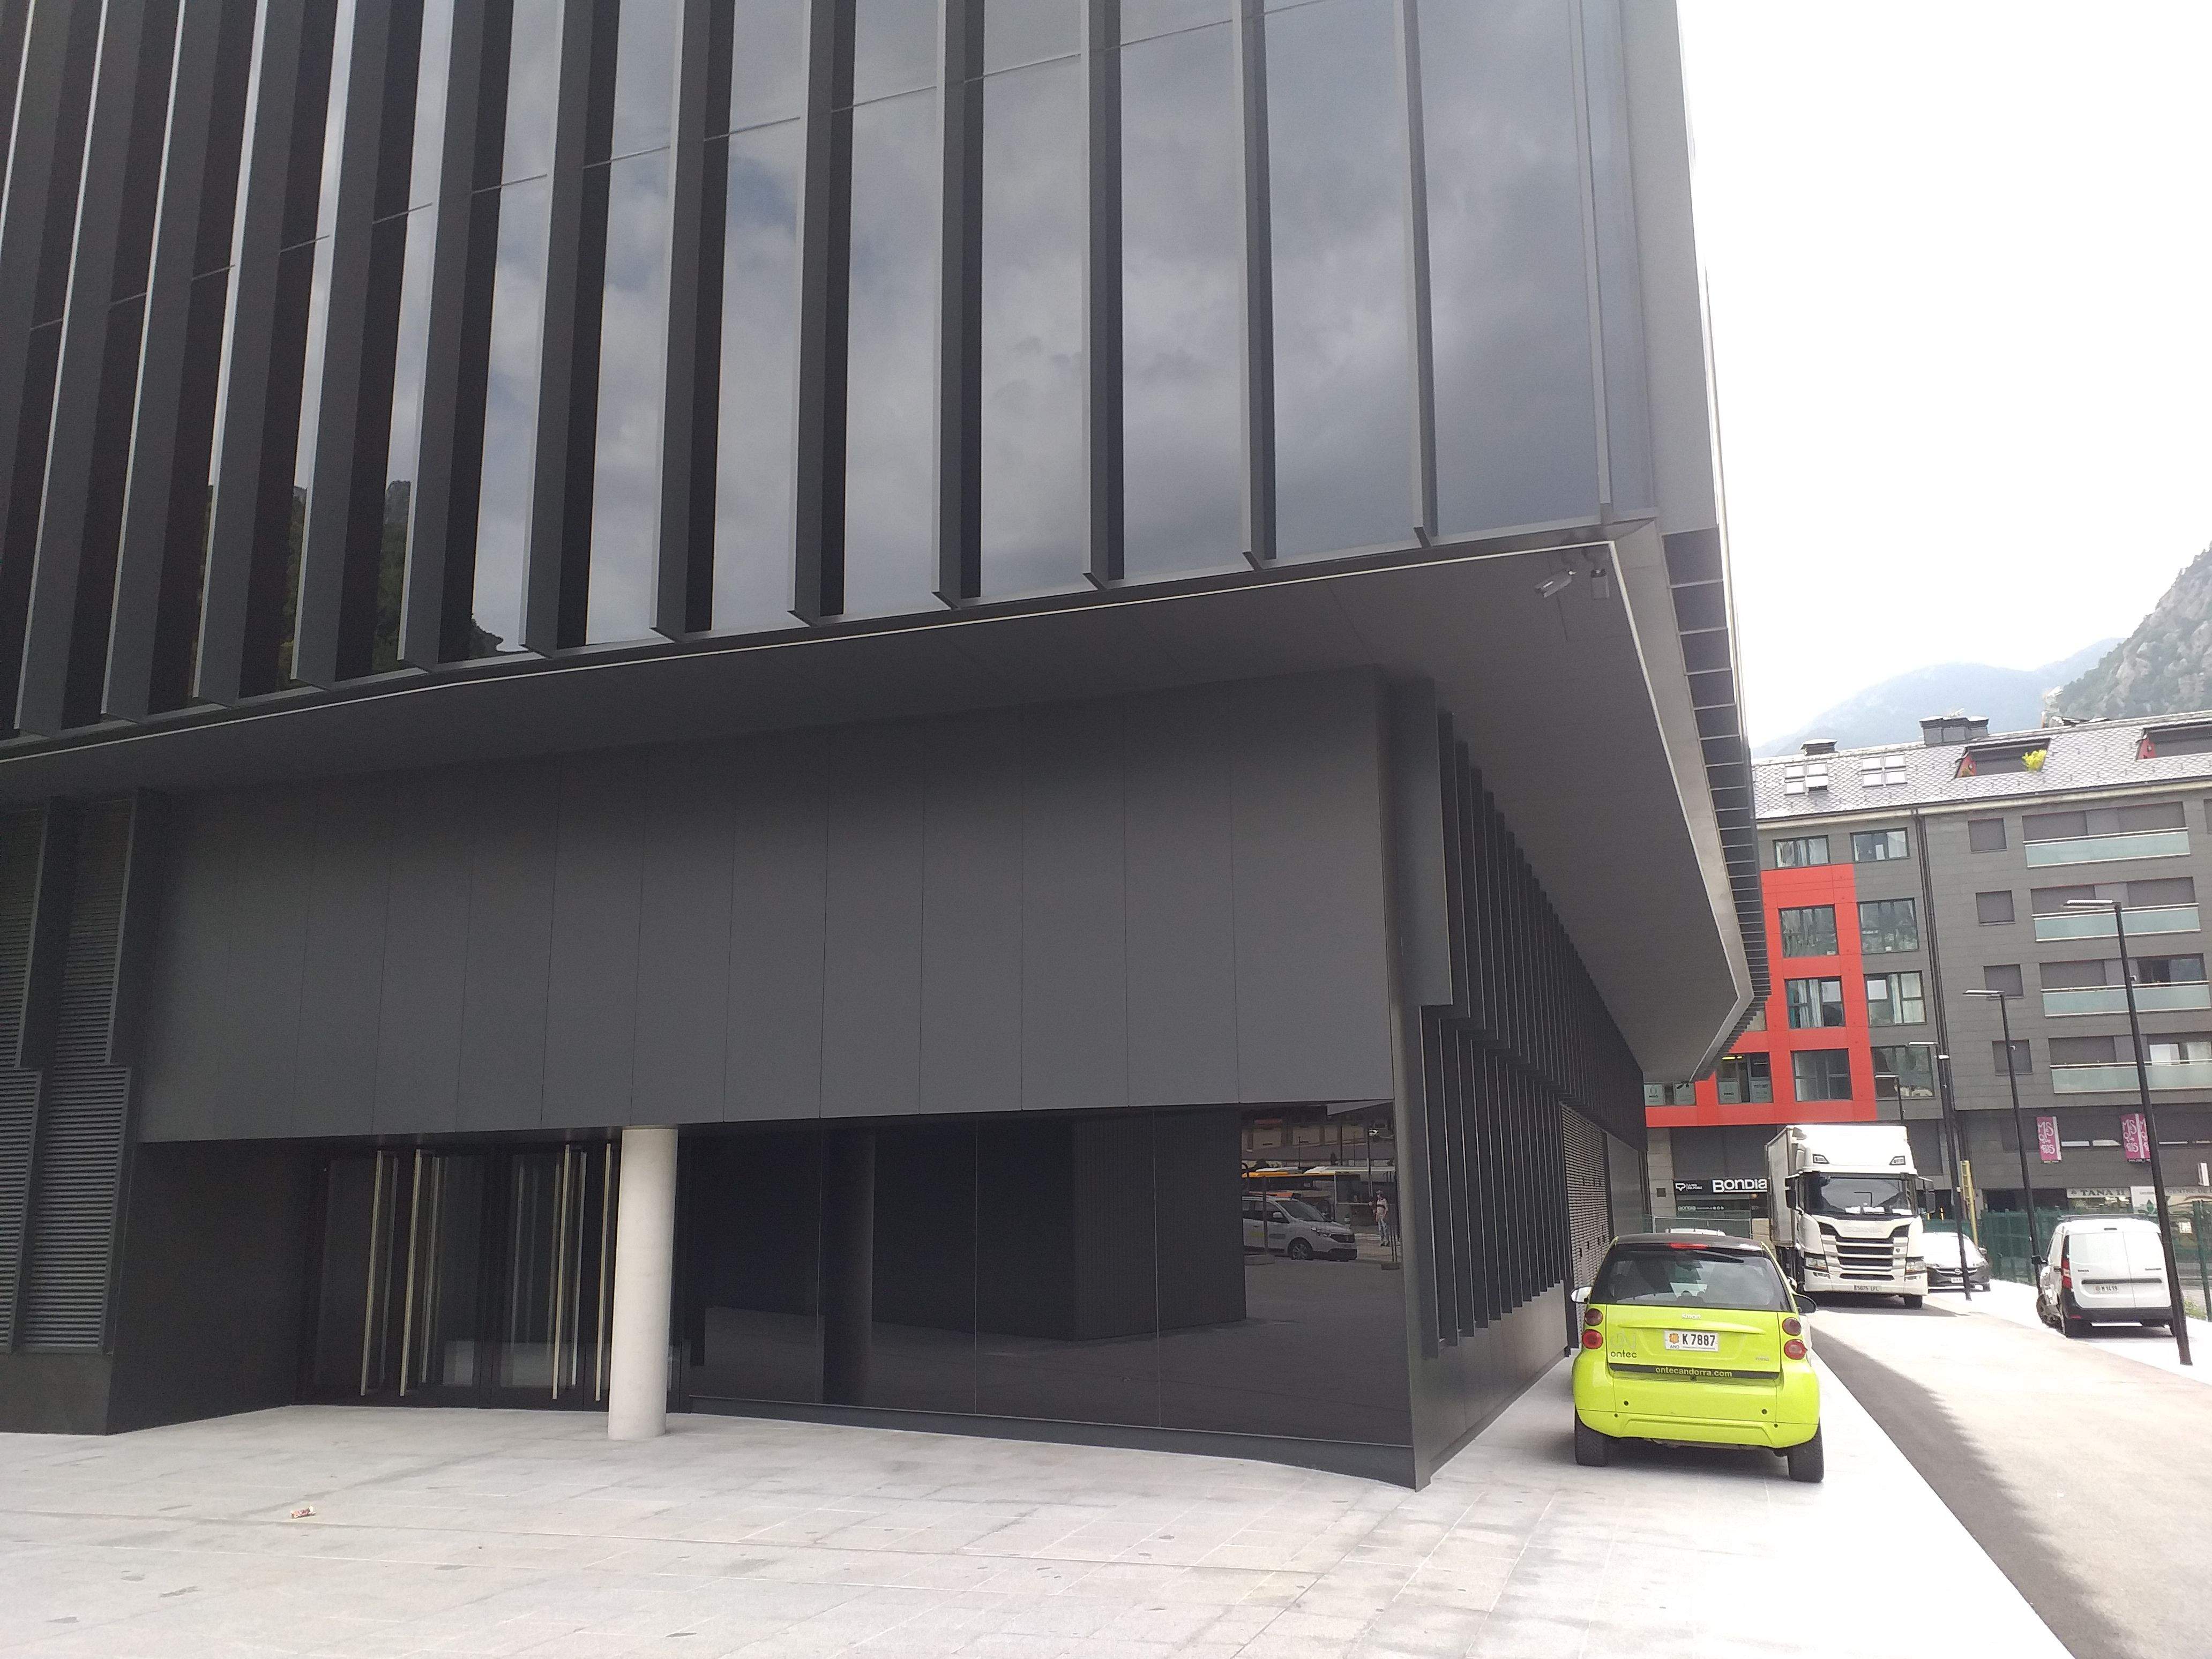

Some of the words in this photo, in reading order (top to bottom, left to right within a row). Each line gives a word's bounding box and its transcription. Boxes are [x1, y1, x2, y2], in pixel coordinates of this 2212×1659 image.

[1682, 1333, 1688, 1345] K
[1691, 1334, 1715, 1346] 7887
[1610, 1349, 1637, 1358] ontec
[1655, 1366, 1732, 1377] ontecandorra.com
